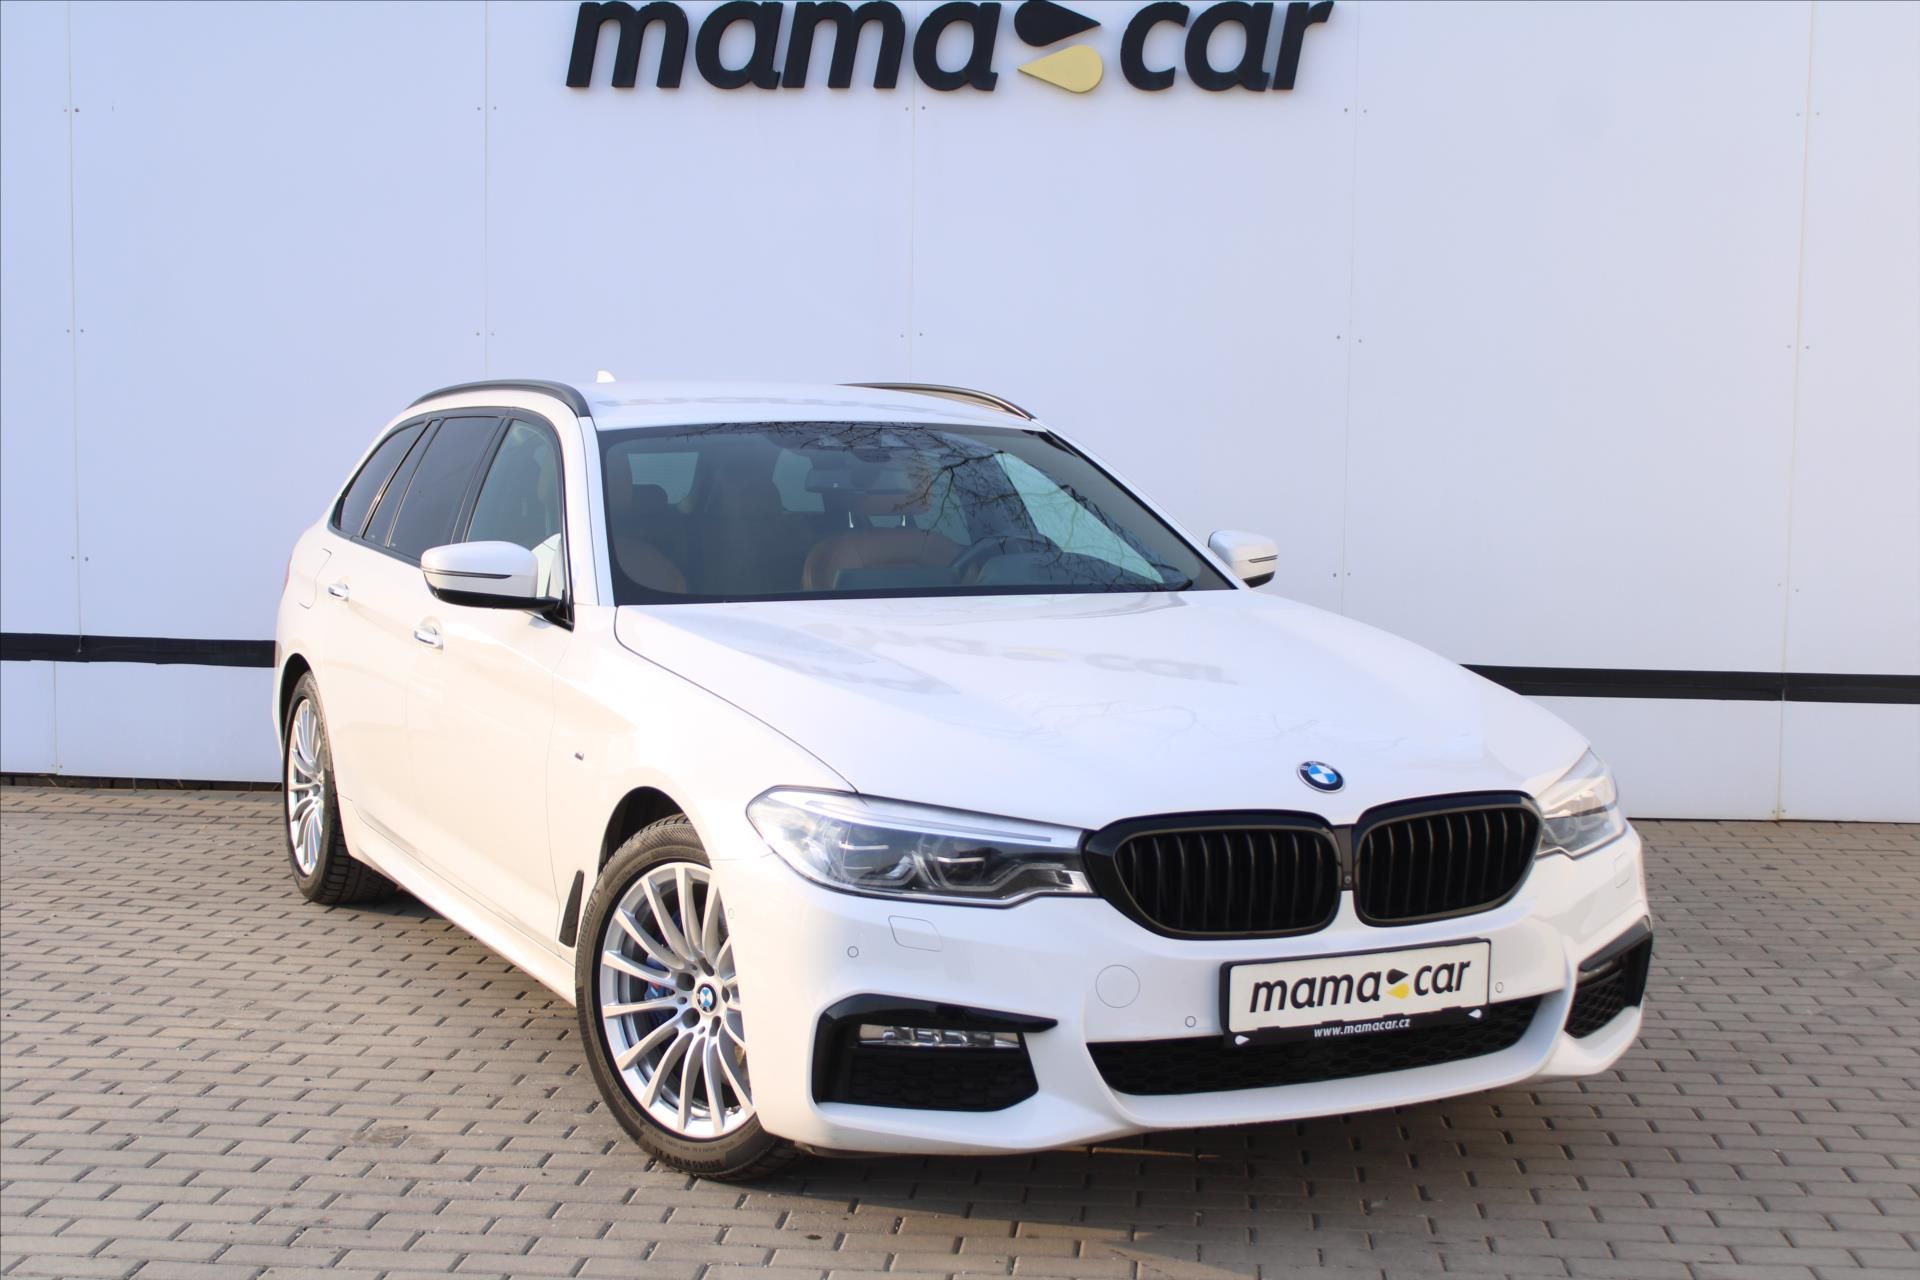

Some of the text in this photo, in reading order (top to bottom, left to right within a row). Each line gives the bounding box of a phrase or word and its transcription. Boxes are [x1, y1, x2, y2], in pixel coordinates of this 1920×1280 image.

[566, 1, 1335, 91] mama car
[1249, 960, 1471, 1013] mama car
[1313, 1018, 1411, 1038] www.mamacar.cz
